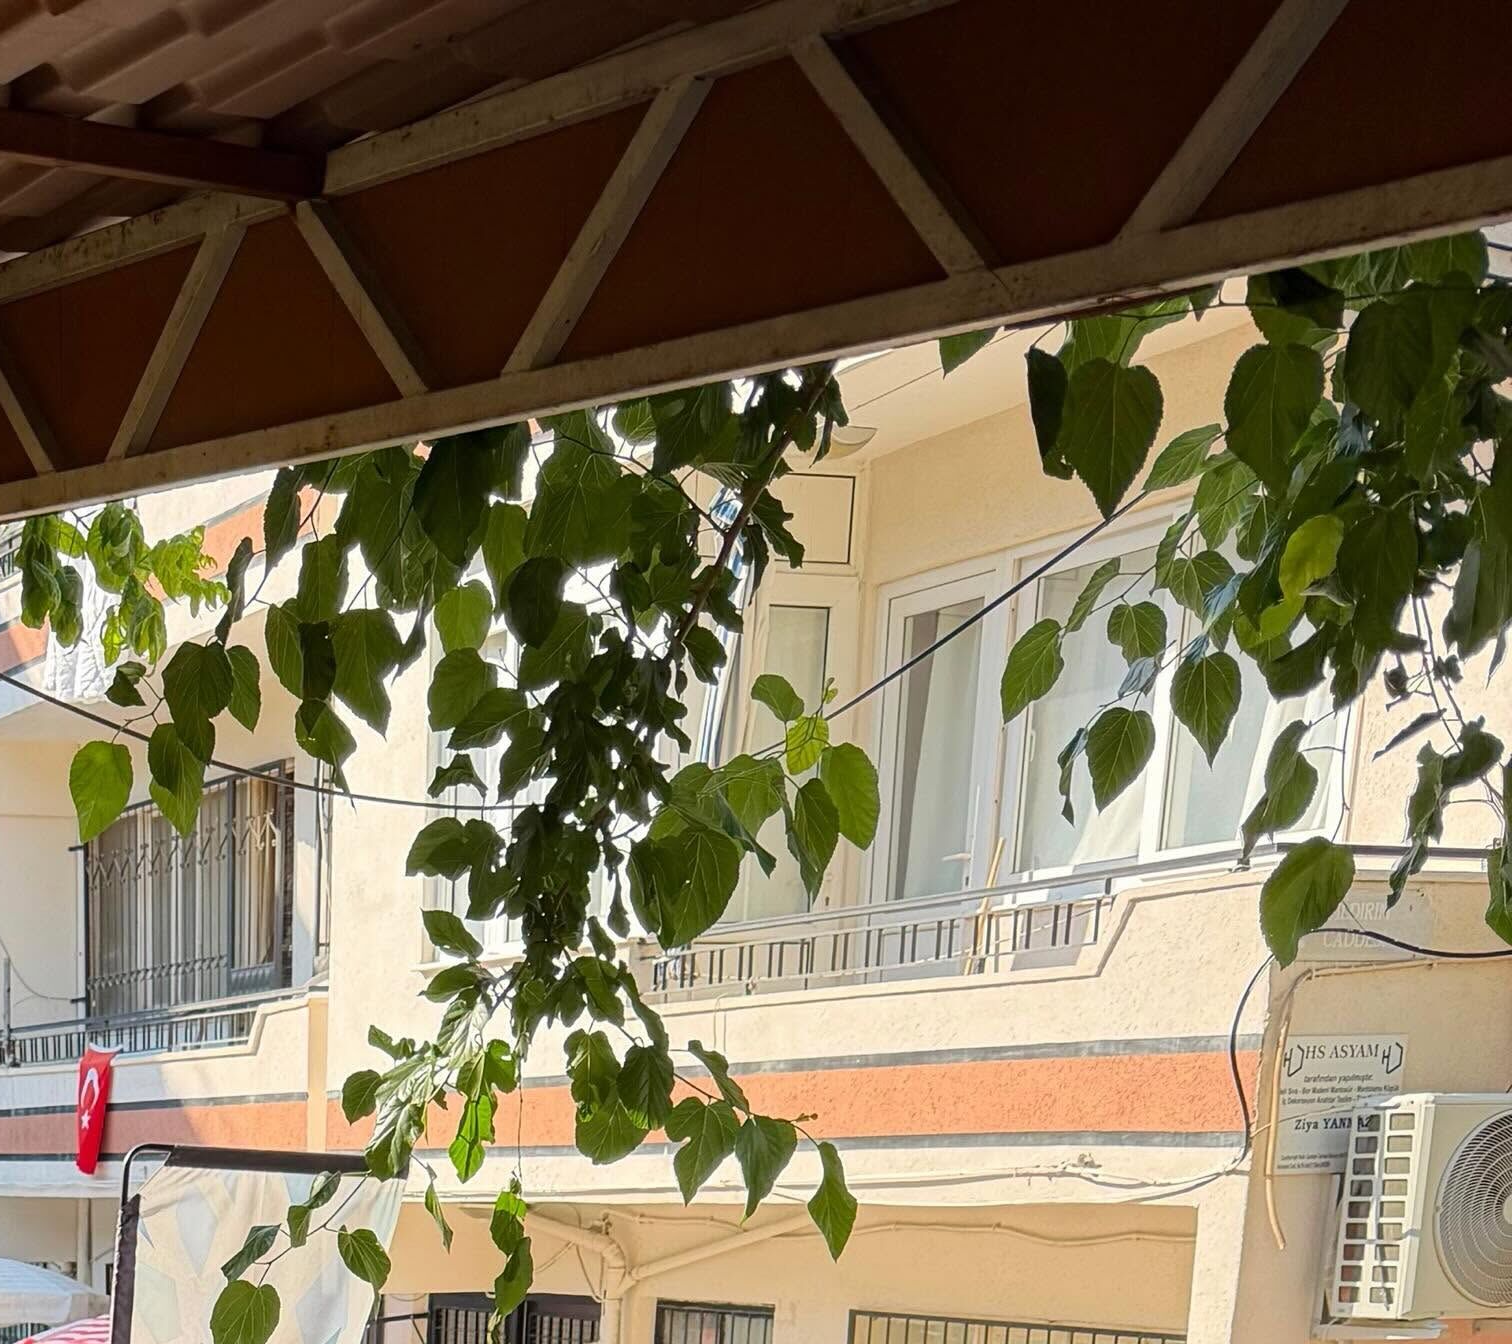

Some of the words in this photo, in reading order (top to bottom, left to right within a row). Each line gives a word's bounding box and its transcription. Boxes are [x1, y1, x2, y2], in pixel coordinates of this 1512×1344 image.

[1305, 1044, 1326, 1060] HS
[1329, 1043, 1380, 1059] ASYAM
[1294, 1118, 1319, 1133] Ziya
